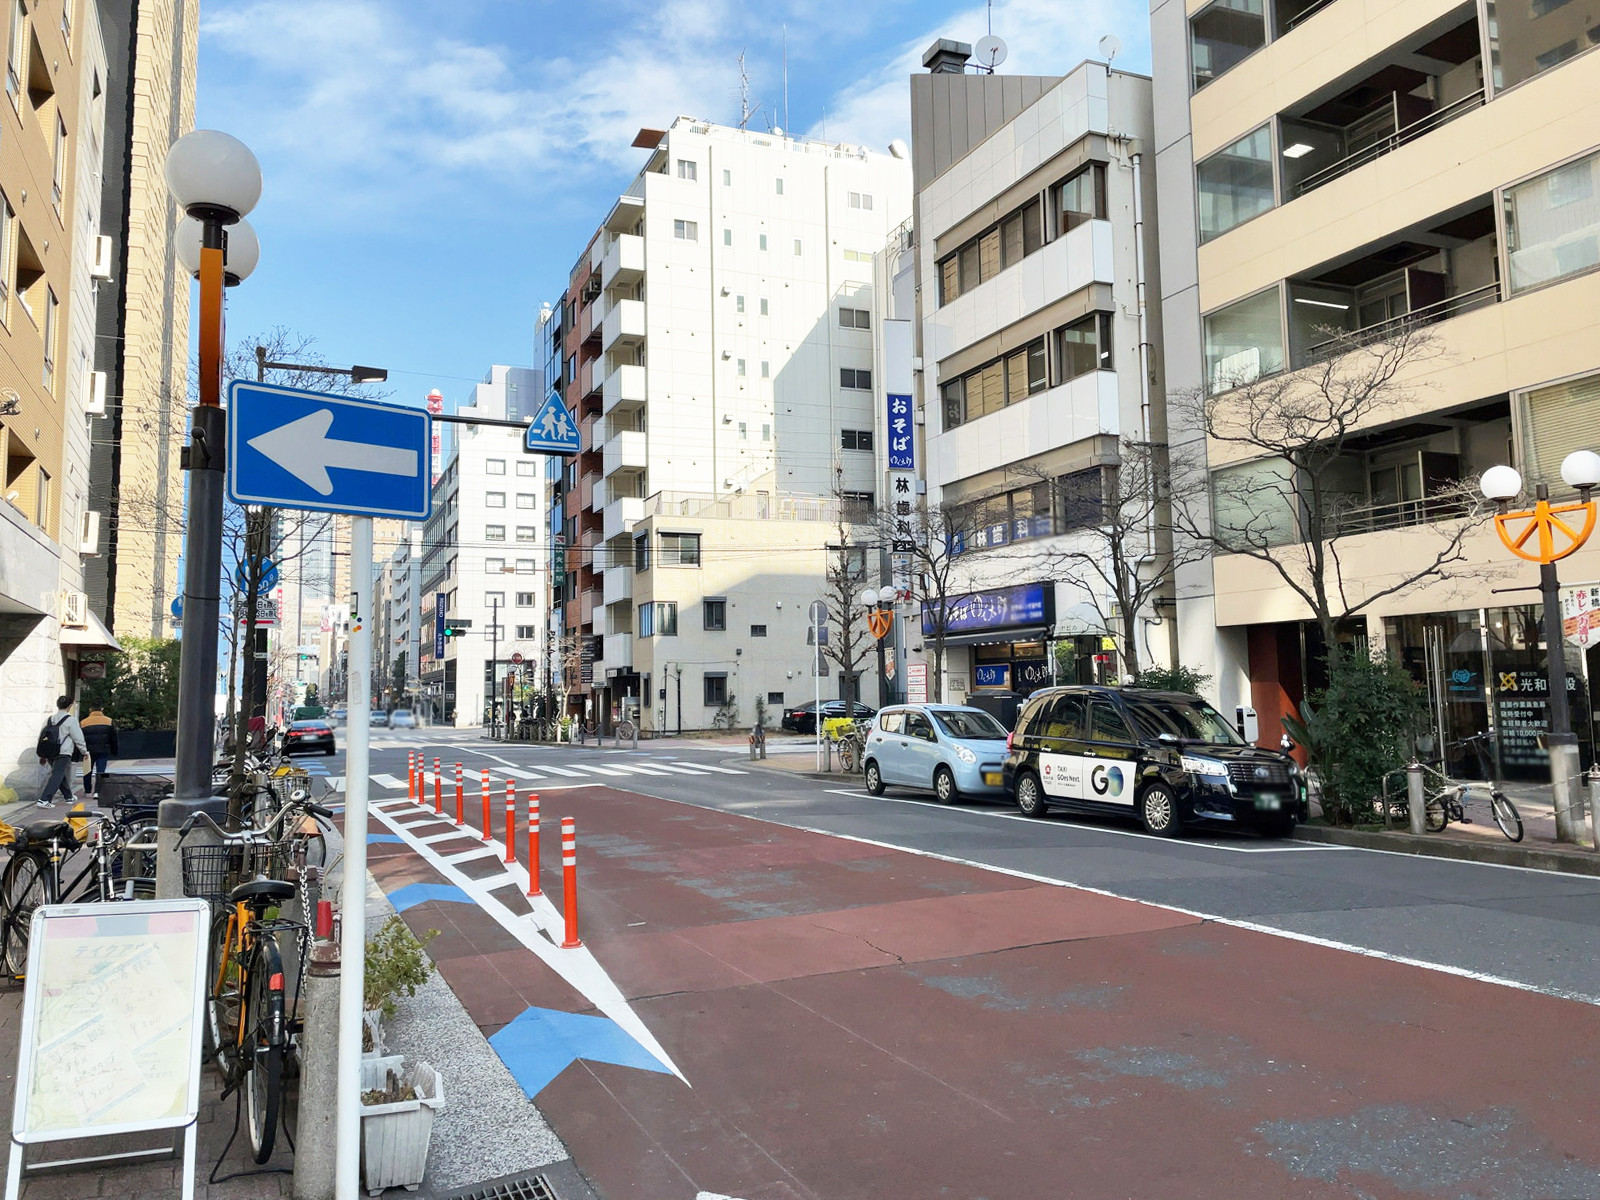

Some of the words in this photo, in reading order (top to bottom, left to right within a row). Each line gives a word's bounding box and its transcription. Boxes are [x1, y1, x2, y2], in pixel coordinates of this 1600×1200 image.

[891, 397, 911, 451] おそば
[895, 477, 910, 535] 林歯科
[976, 519, 1029, 547] 林歯科
[1521, 678, 1576, 692] 光和設
